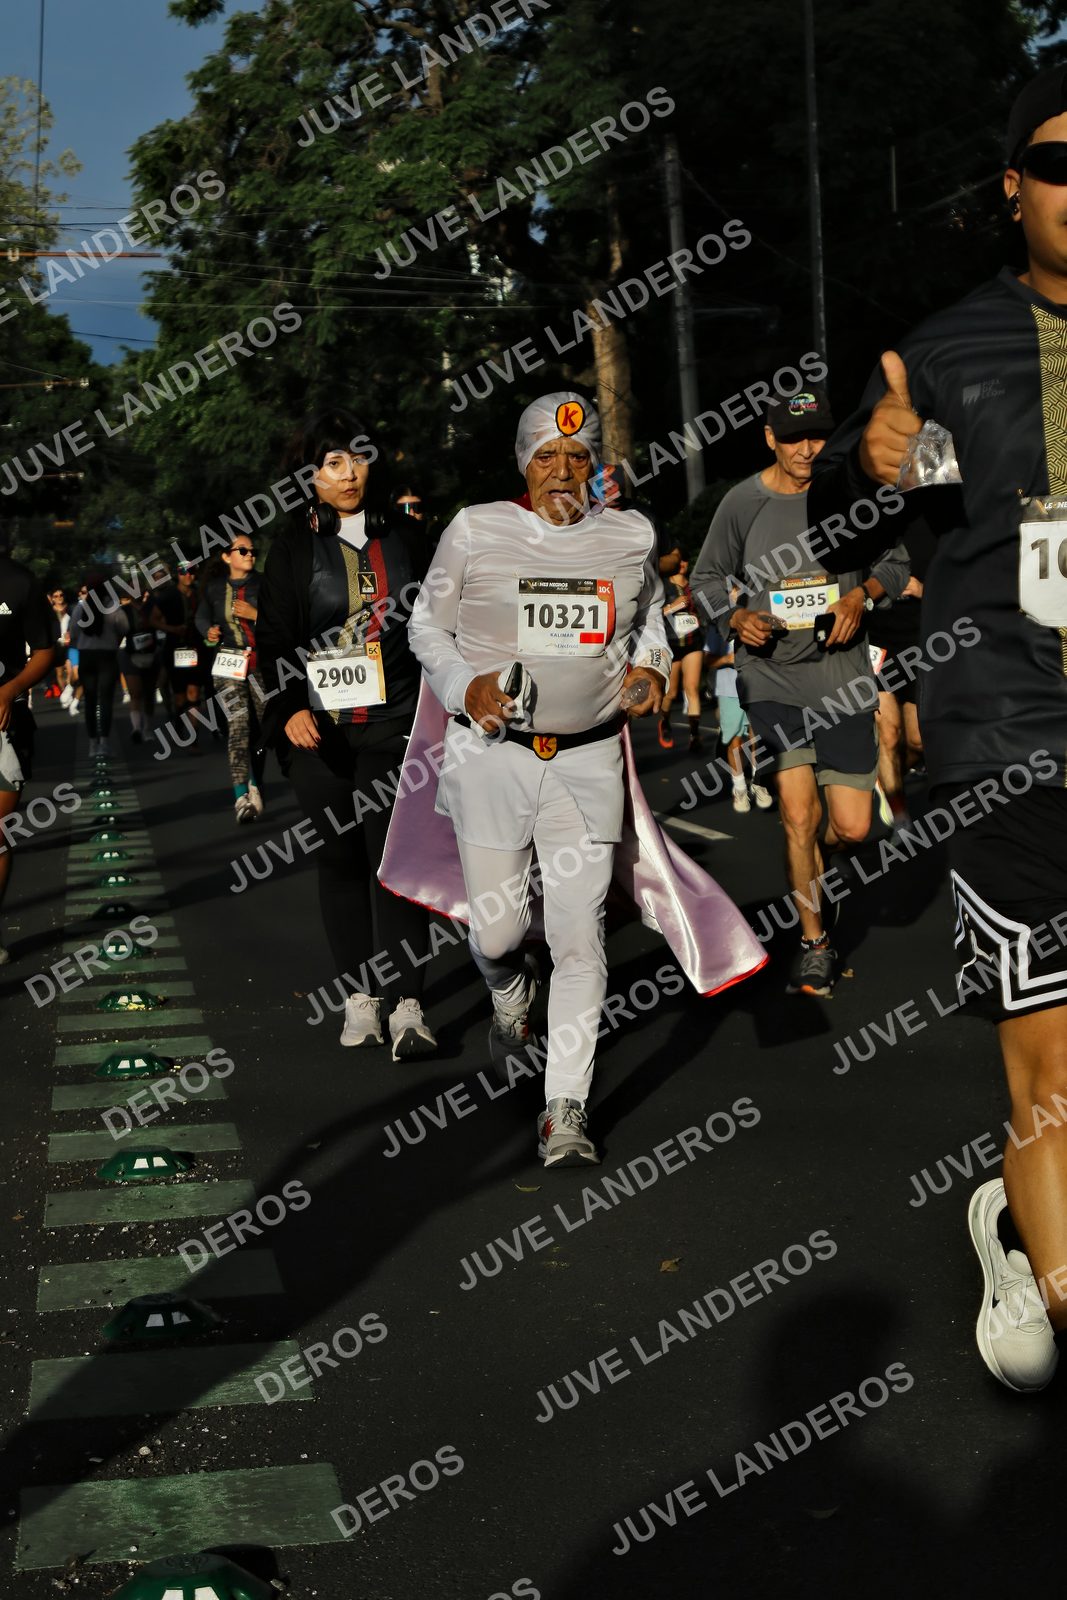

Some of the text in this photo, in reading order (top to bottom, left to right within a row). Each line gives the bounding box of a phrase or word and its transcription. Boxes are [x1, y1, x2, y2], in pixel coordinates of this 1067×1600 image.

[562, 405, 578, 428] K
[784, 593, 827, 609] 9935
[523, 603, 599, 629] 10321
[216, 656, 244, 669] 12647
[316, 664, 367, 689] 2900
[539, 736, 553, 752] K
